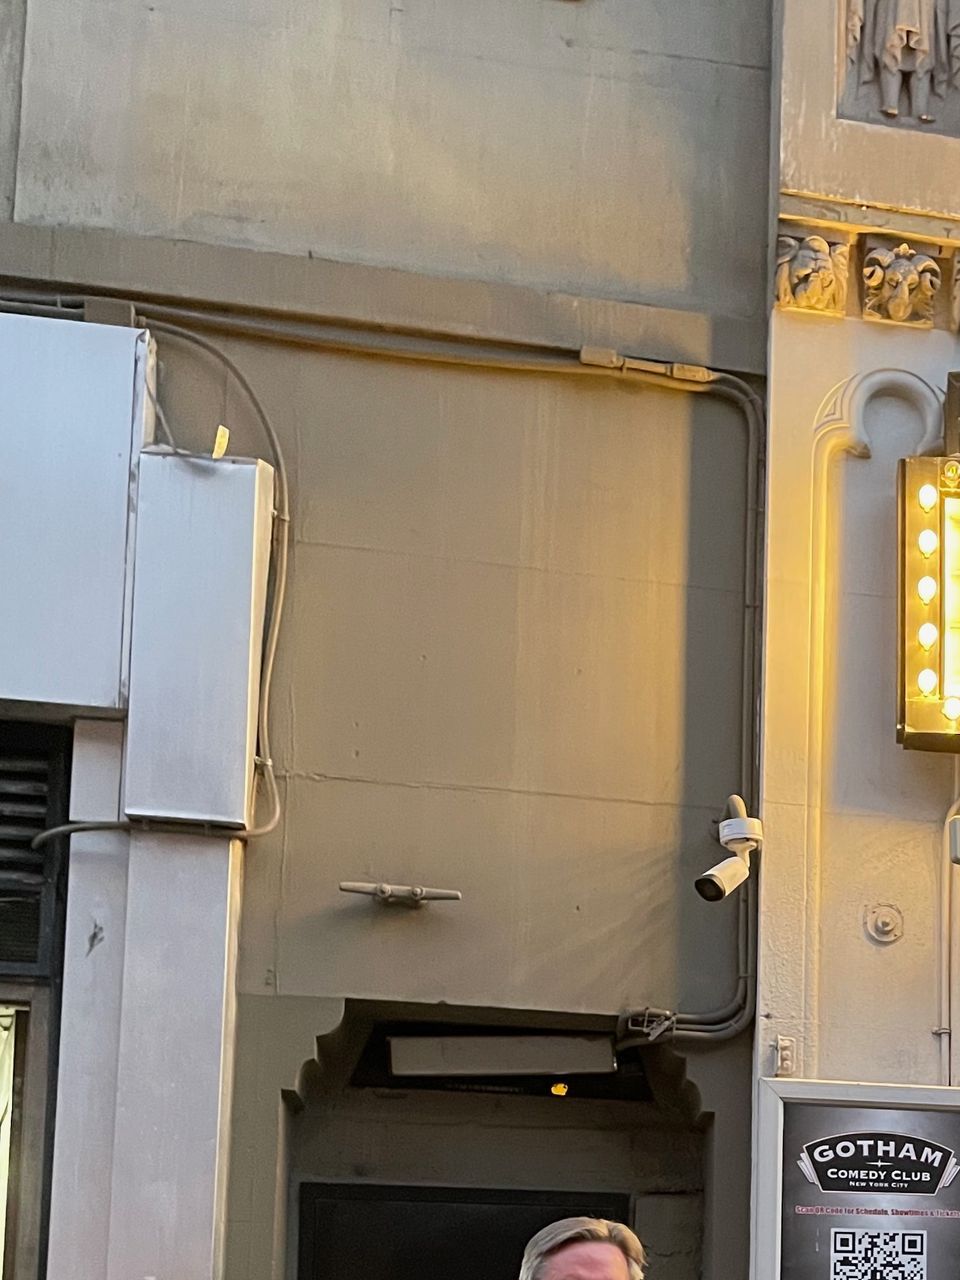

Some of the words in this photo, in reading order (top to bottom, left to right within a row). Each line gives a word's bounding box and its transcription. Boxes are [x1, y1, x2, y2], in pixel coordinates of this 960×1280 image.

[813, 1140, 943, 1167] GOTHAM
[827, 1168, 887, 1180] COMEDY
[891, 1170, 930, 1181] CLUB
